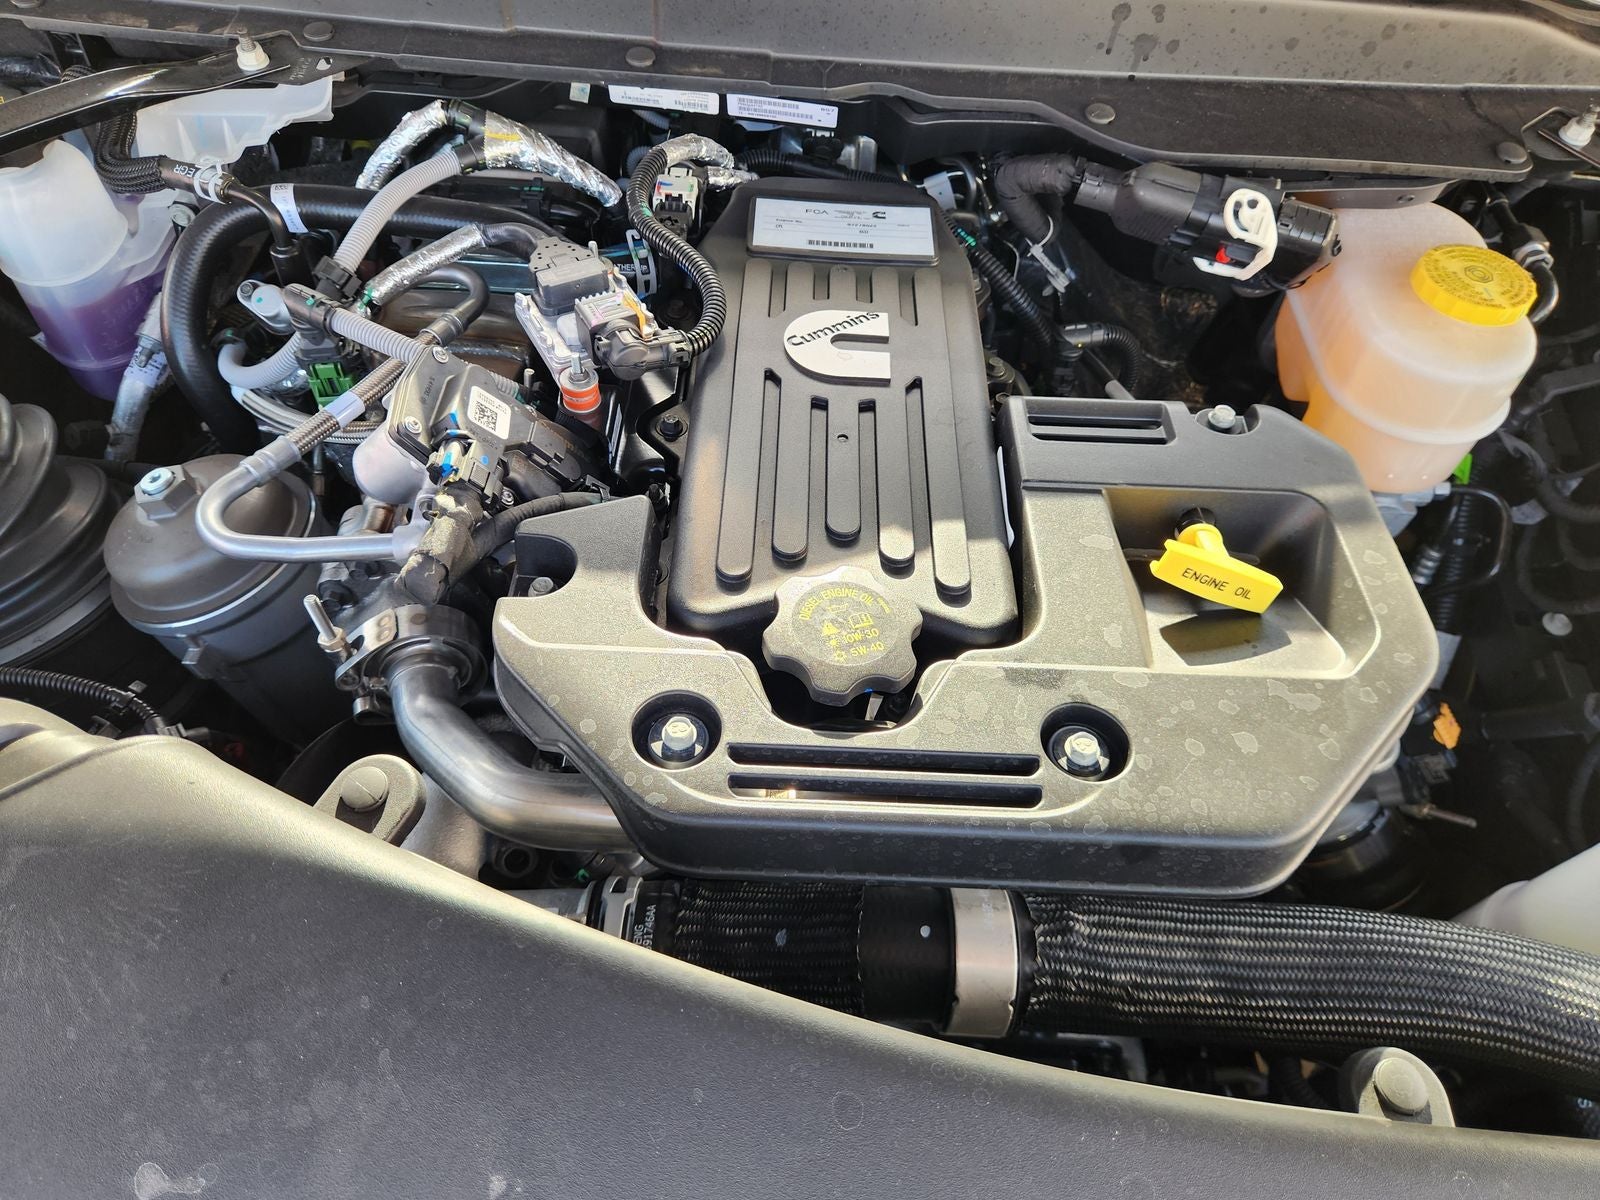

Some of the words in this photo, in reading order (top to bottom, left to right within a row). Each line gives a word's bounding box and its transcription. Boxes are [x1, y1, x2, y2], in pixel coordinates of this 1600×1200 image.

[173, 164, 196, 178] EGR
[805, 208, 829, 216] FCA
[786, 312, 880, 346] Cummins
[1181, 567, 1229, 592] ENGINE
[1234, 586, 1252, 600] OIL
[799, 596, 823, 620] DIESEL
[821, 587, 859, 600] ENGINE
[860, 592, 875, 606] OIL
[843, 627, 879, 644] 10W-30
[850, 641, 885, 657] 5W-40
